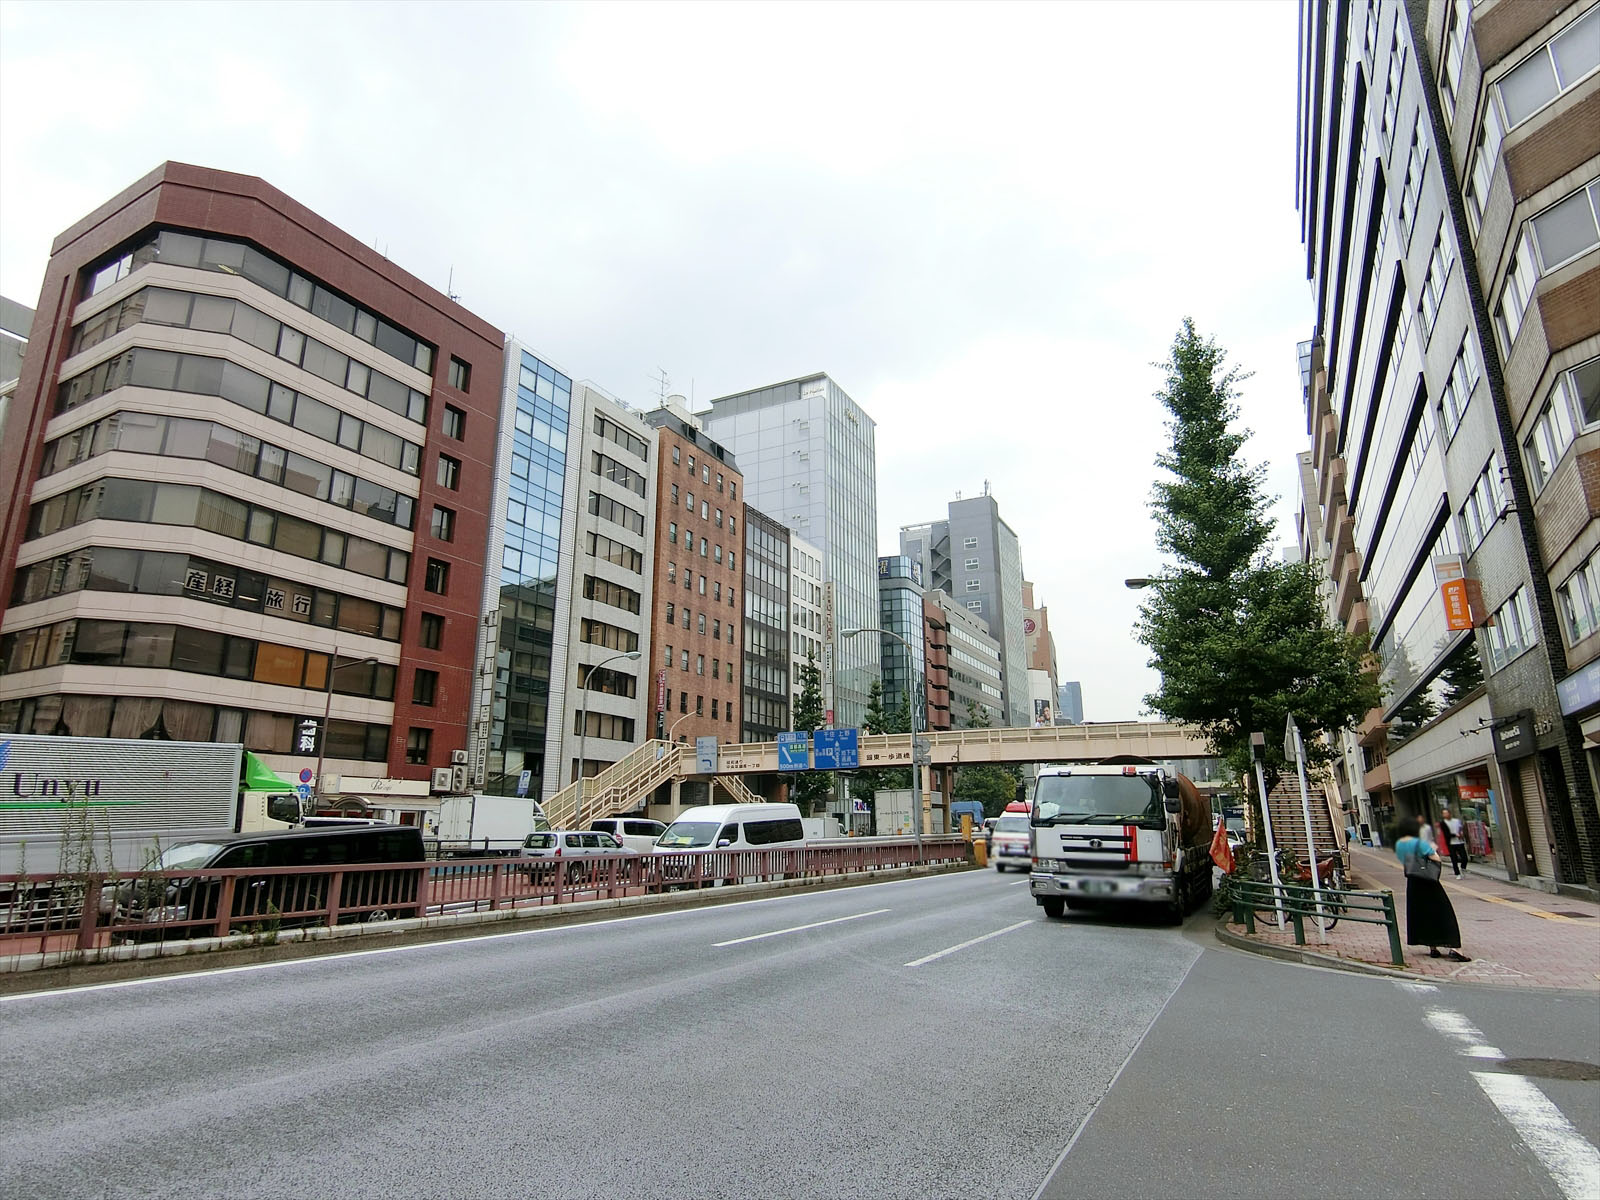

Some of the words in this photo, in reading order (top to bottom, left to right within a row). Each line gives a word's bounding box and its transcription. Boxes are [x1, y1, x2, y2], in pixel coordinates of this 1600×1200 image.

[185, 570, 311, 614] 産経旅行
[14, 772, 101, 803] Unyu
[522, 771, 530, 780] P
